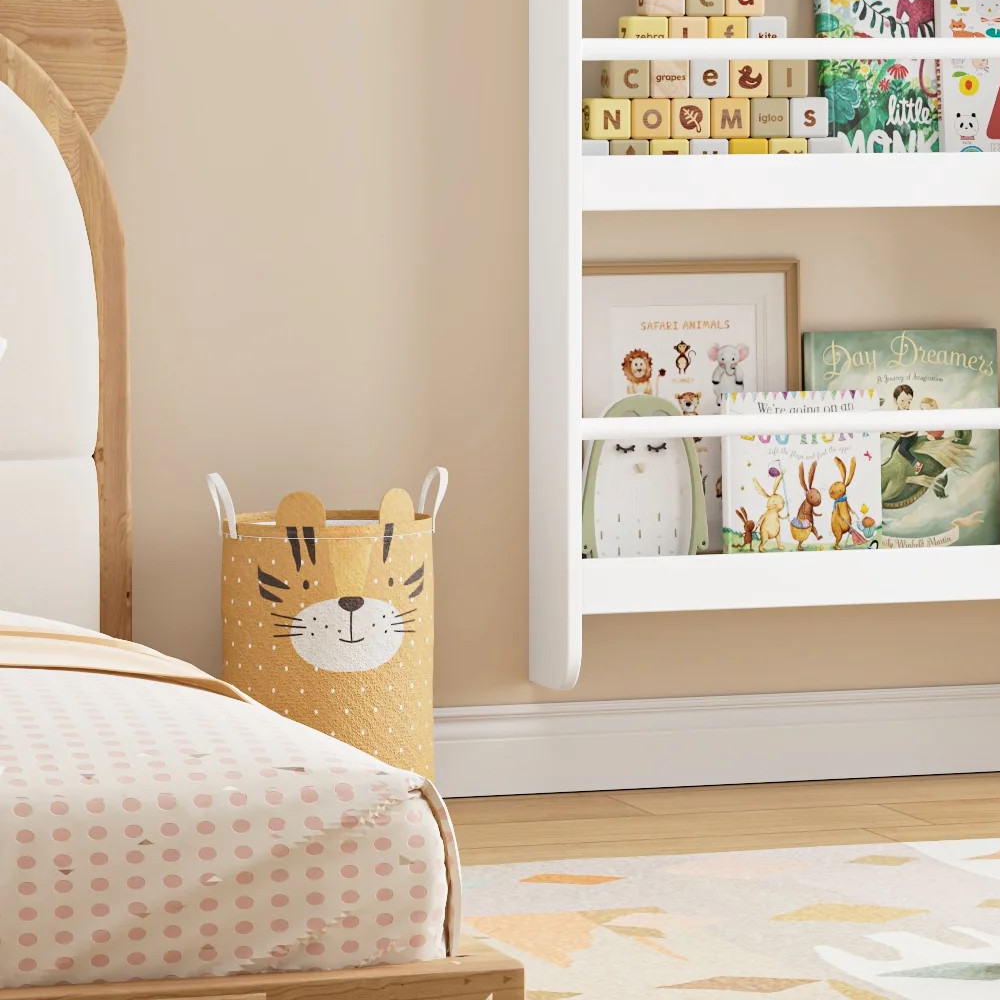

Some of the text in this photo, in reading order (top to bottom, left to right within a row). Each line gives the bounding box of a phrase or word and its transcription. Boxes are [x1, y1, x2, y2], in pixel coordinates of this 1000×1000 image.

[656, 72, 686, 83] grapes
[702, 68, 719, 87] e
[603, 109, 621, 130] N
[720, 108, 743, 130] M
[758, 112, 784, 124] igloo
[885, 94, 933, 127] little
[837, 129, 939, 153] MONK
[640, 320, 731, 331] SAFARI ANIMALS
[822, 330, 994, 380] Day Dreamers
[757, 401, 786, 414] We're
[823, 404, 838, 413] on
[840, 402, 854, 411] an
[882, 539, 894, 548] ily
